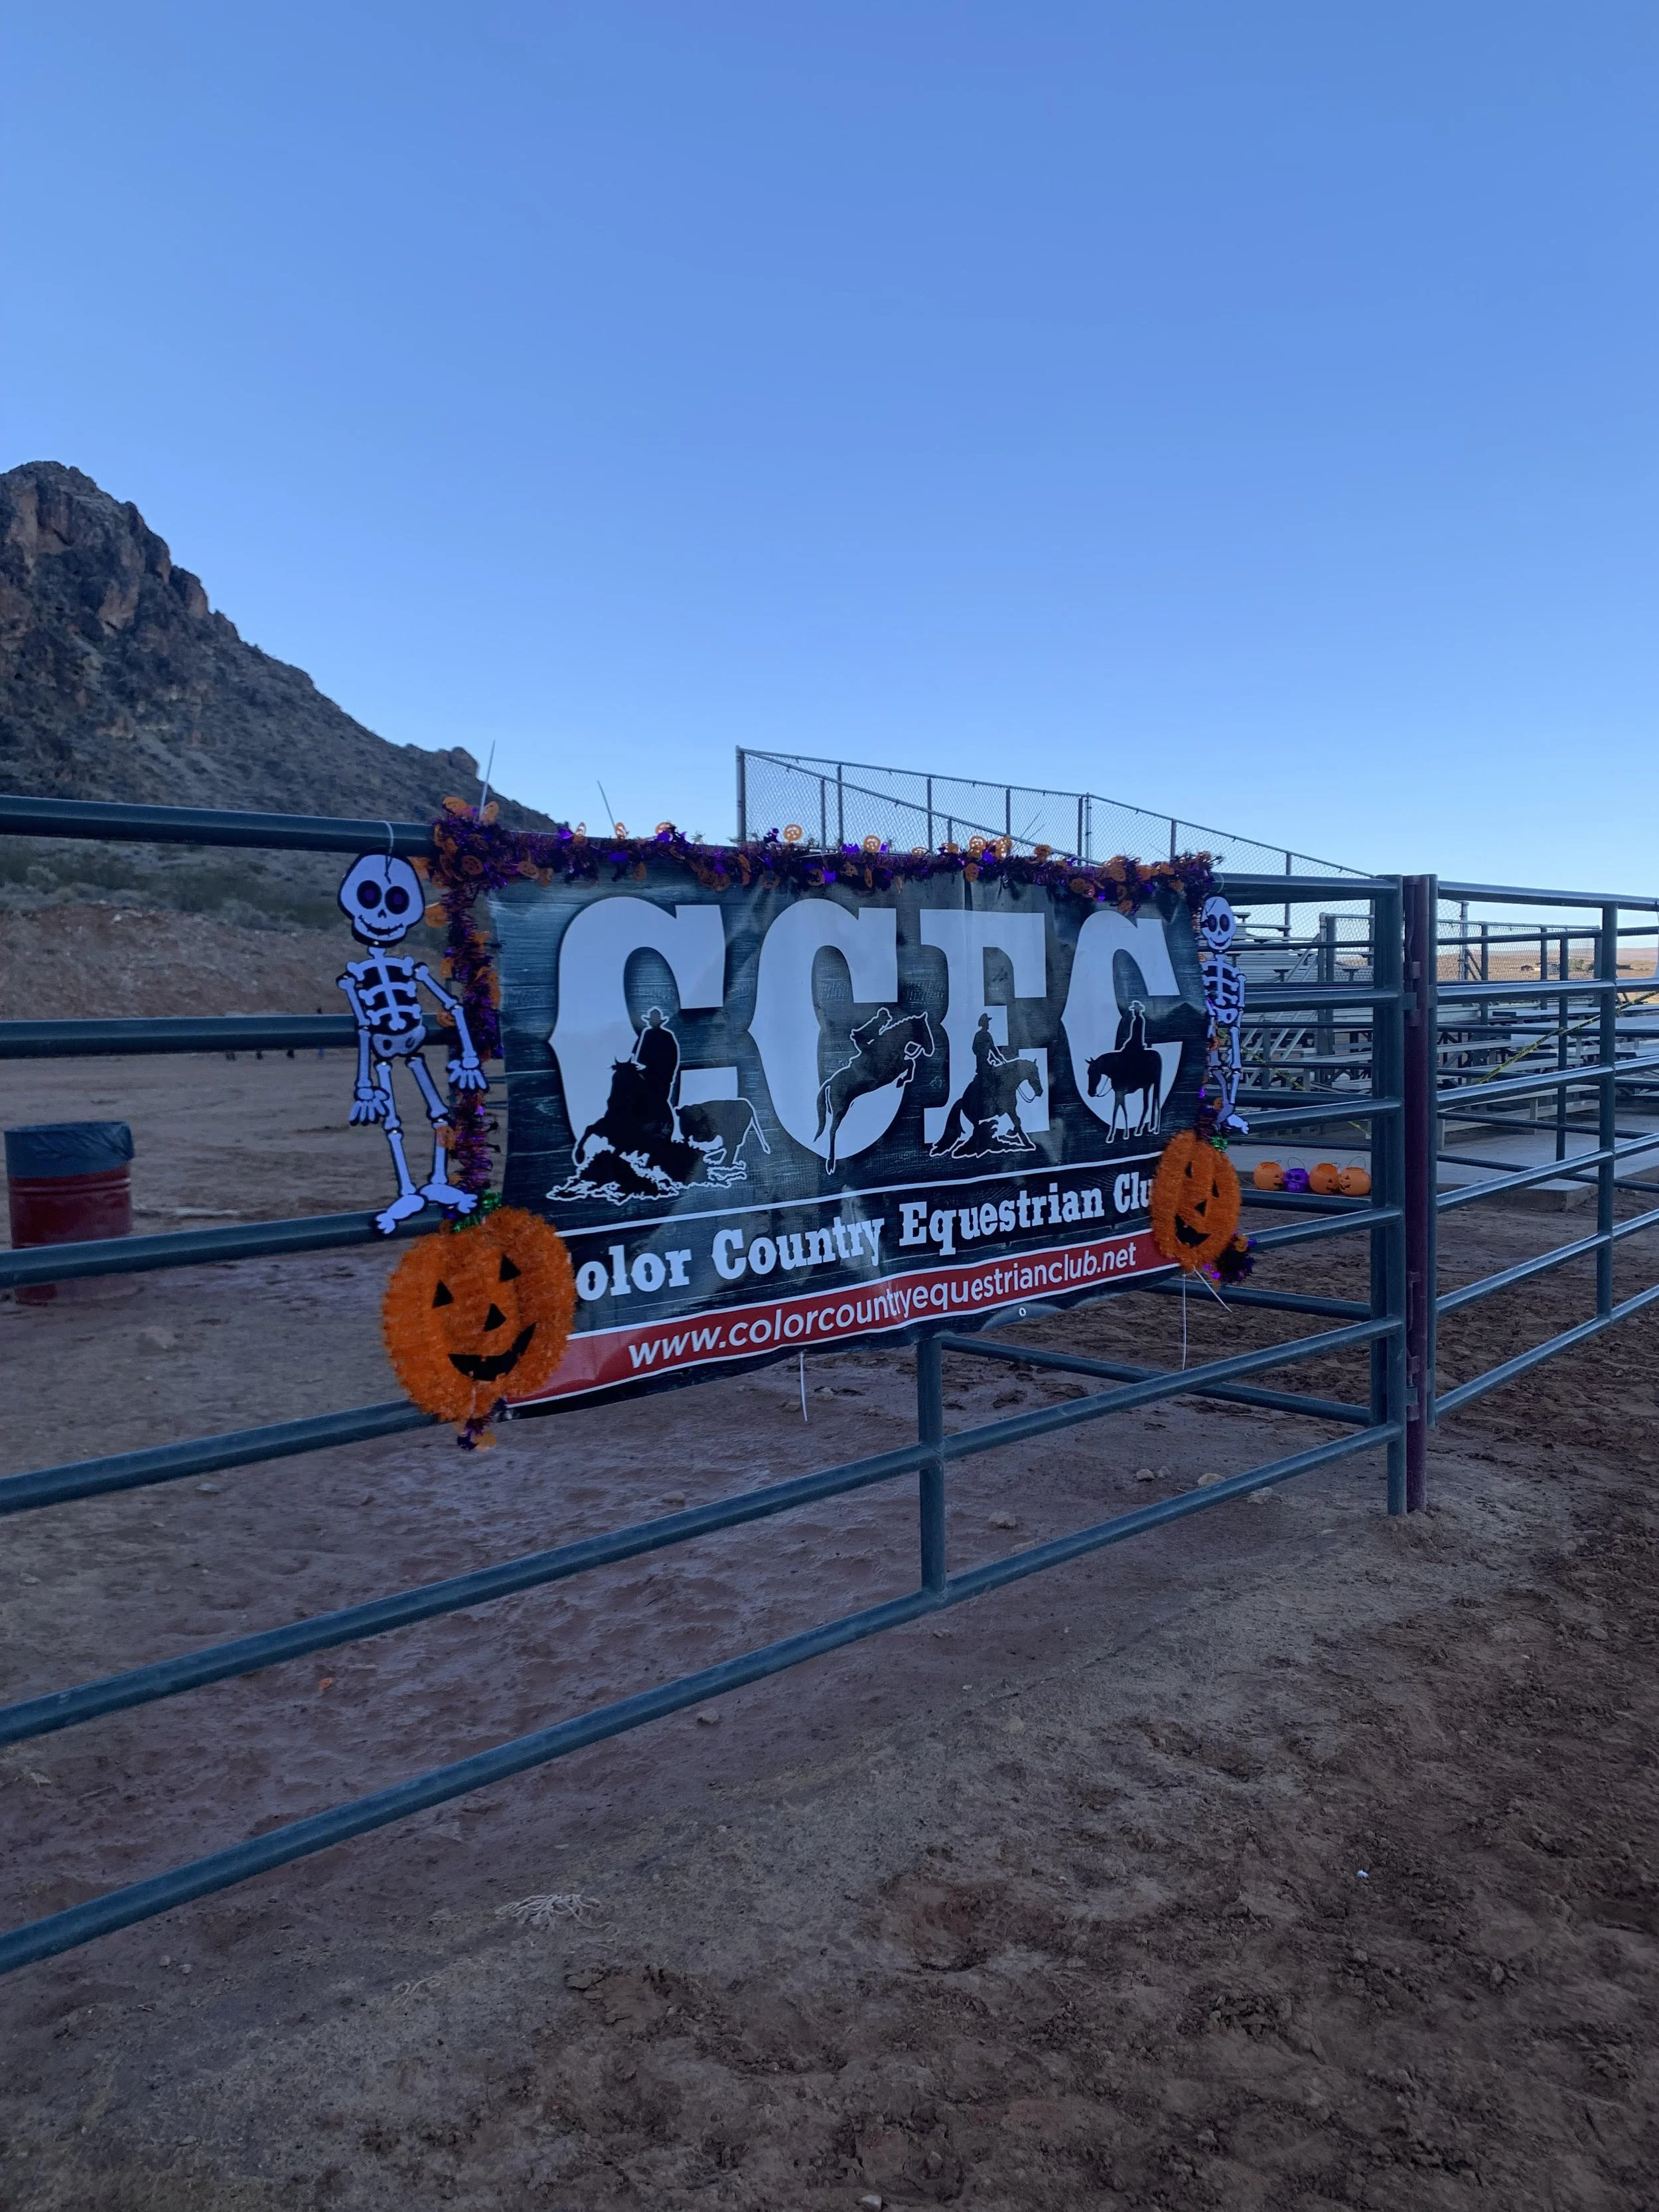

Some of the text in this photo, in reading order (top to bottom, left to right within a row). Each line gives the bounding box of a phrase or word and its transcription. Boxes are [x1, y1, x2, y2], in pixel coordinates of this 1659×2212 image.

[549, 897, 1184, 1163] CCEC
[567, 1171, 1155, 1301] olor Country Equestrian Clu
[628, 1242, 1136, 1369] www.colorcountryequestrianclub.net
